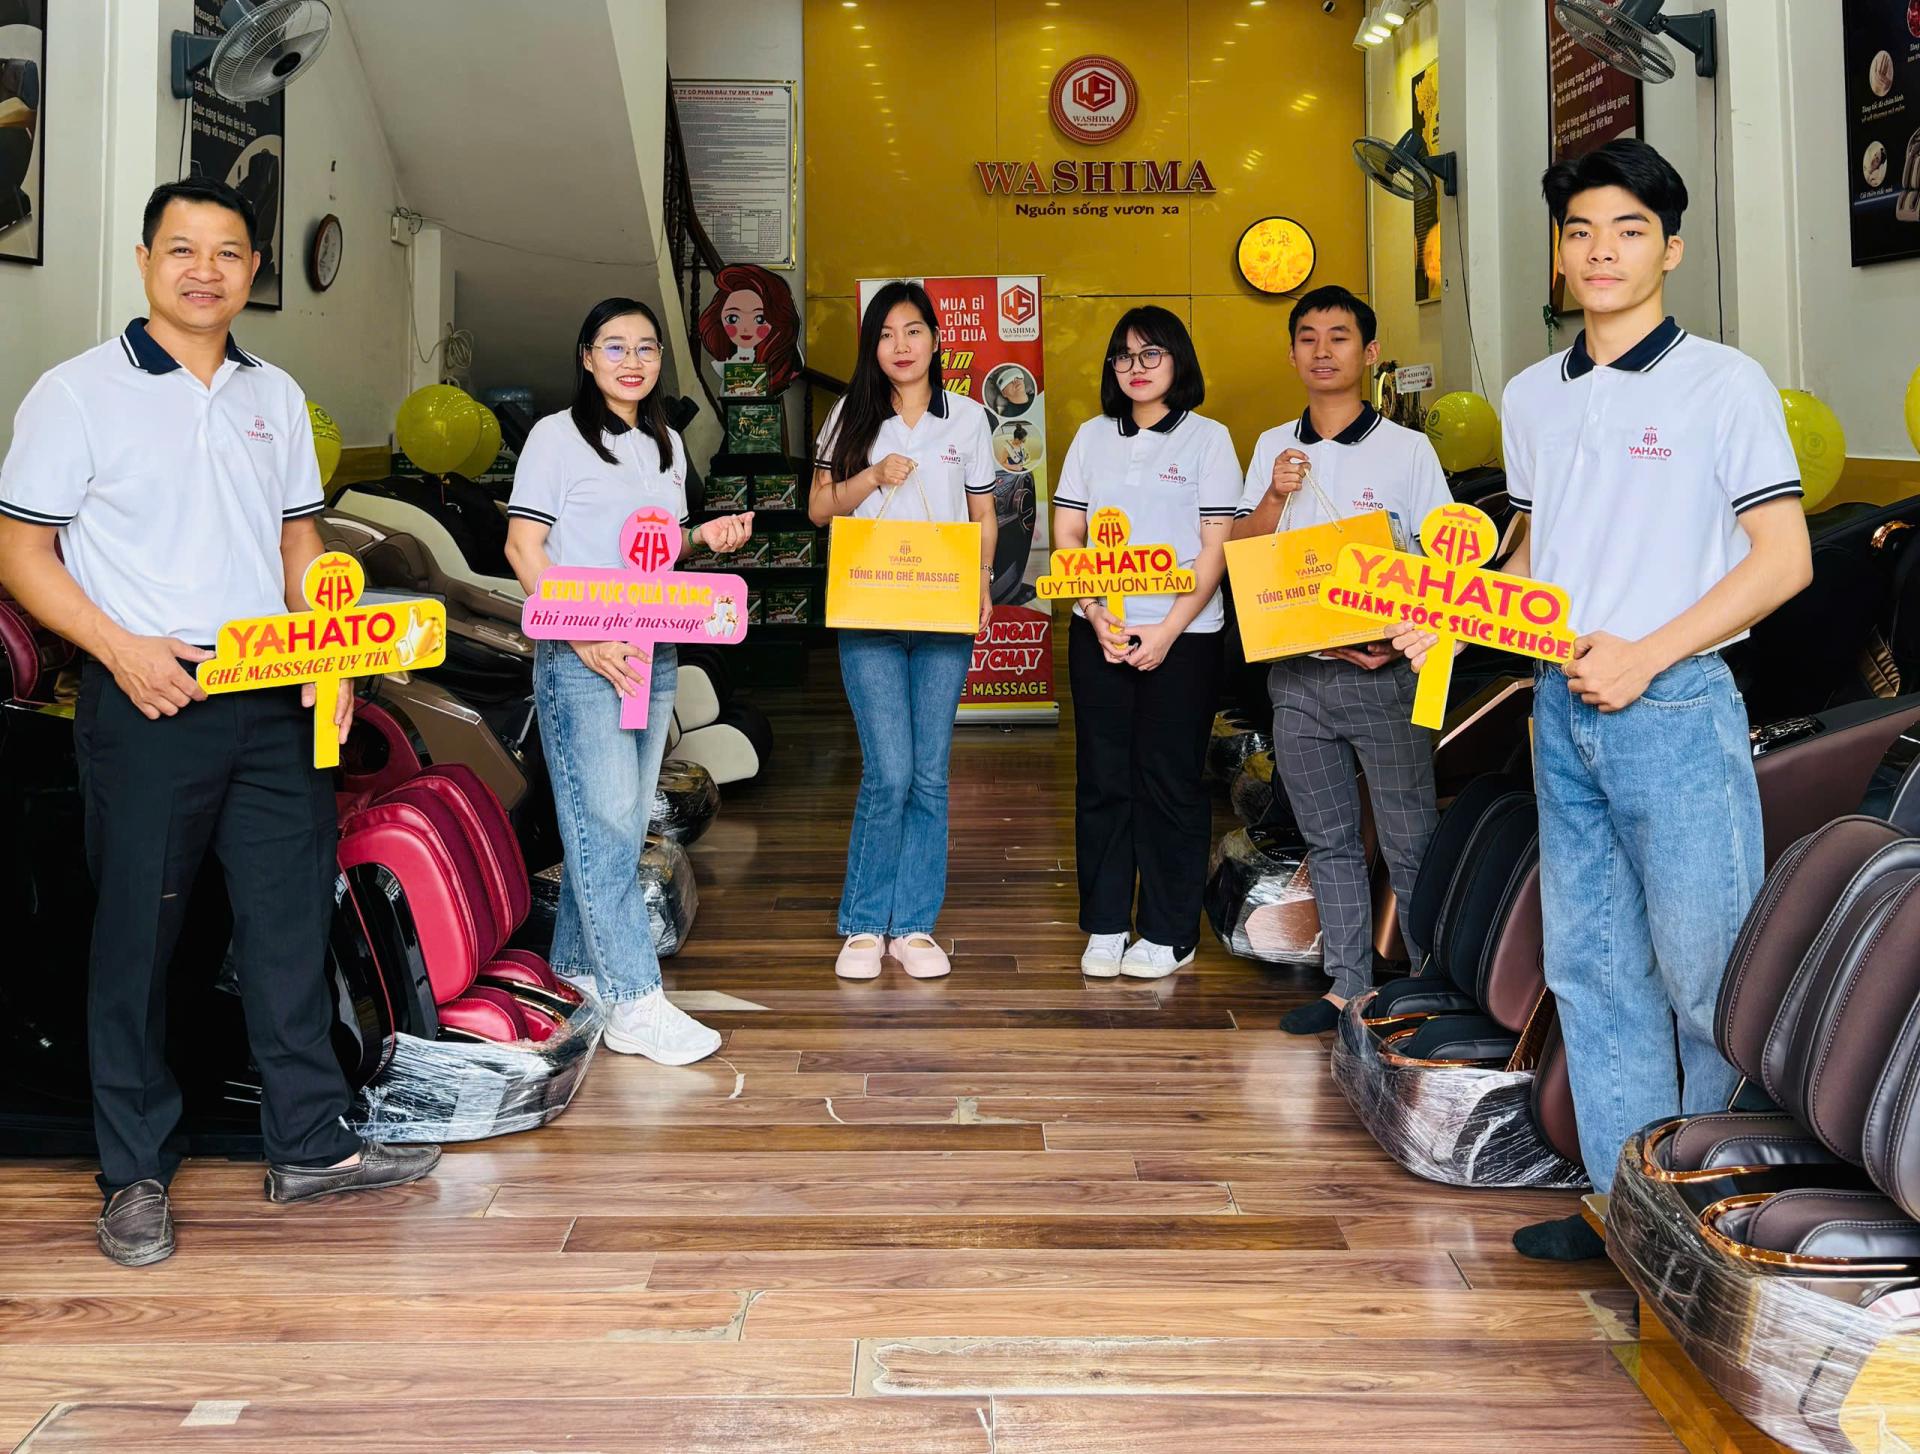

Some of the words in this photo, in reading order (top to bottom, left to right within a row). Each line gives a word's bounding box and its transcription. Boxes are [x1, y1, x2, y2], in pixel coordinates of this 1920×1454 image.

[1073, 115, 1115, 123] WASHIMA
[976, 160, 1216, 194] WASHIMA
[1016, 202, 1066, 218] Nguồn
[1073, 202, 1108, 217] sống
[1113, 205, 1154, 215] vươn
[1162, 205, 1179, 214] xa
[940, 298, 966, 311] MUA
[972, 295, 985, 310] GÌ
[946, 311, 980, 326] CŨNG
[940, 327, 956, 342] CÓ
[961, 326, 987, 342] QUÀ
[1628, 446, 1672, 457] YAHATO
[1158, 473, 1187, 482] YAHATO
[1352, 500, 1384, 509] YAHATO
[889, 556, 922, 564] YAHATO
[1057, 549, 1172, 576] YAHATO
[849, 565, 873, 579] TỔNG
[875, 569, 893, 581] KHO
[896, 568, 914, 581] GHẾ
[916, 572, 960, 583] MASSAGE
[1296, 563, 1332, 577] YAHATO
[541, 579, 584, 601] KHU
[1041, 581, 1063, 595] UY
[1067, 577, 1094, 594] TÍN
[1098, 577, 1148, 592] VƯƠN
[1151, 570, 1192, 590] TẦM
[1351, 549, 1561, 625] YAHATO
[1256, 588, 1283, 604] TỔNG
[1286, 586, 1306, 600] KHO
[1308, 583, 1320, 596] GH
[562, 614, 600, 627] mua
[602, 610, 636, 631] ghế
[636, 616, 704, 633] massage
[1327, 586, 1395, 617] CHĂM
[1400, 602, 1444, 630] SÓC
[1449, 614, 1493, 641] SỨC
[1498, 630, 1573, 660] KHỎE
[227, 612, 396, 659] YAHATO
[991, 622, 1048, 644] NGAY
[206, 660, 244, 687] GHẾ
[245, 657, 336, 681] MASSSAGE
[338, 653, 359, 671] UY
[365, 647, 394, 668] TÍN
[988, 648, 1044, 676] CHẠY
[972, 681, 1048, 696] MASSSAGE
